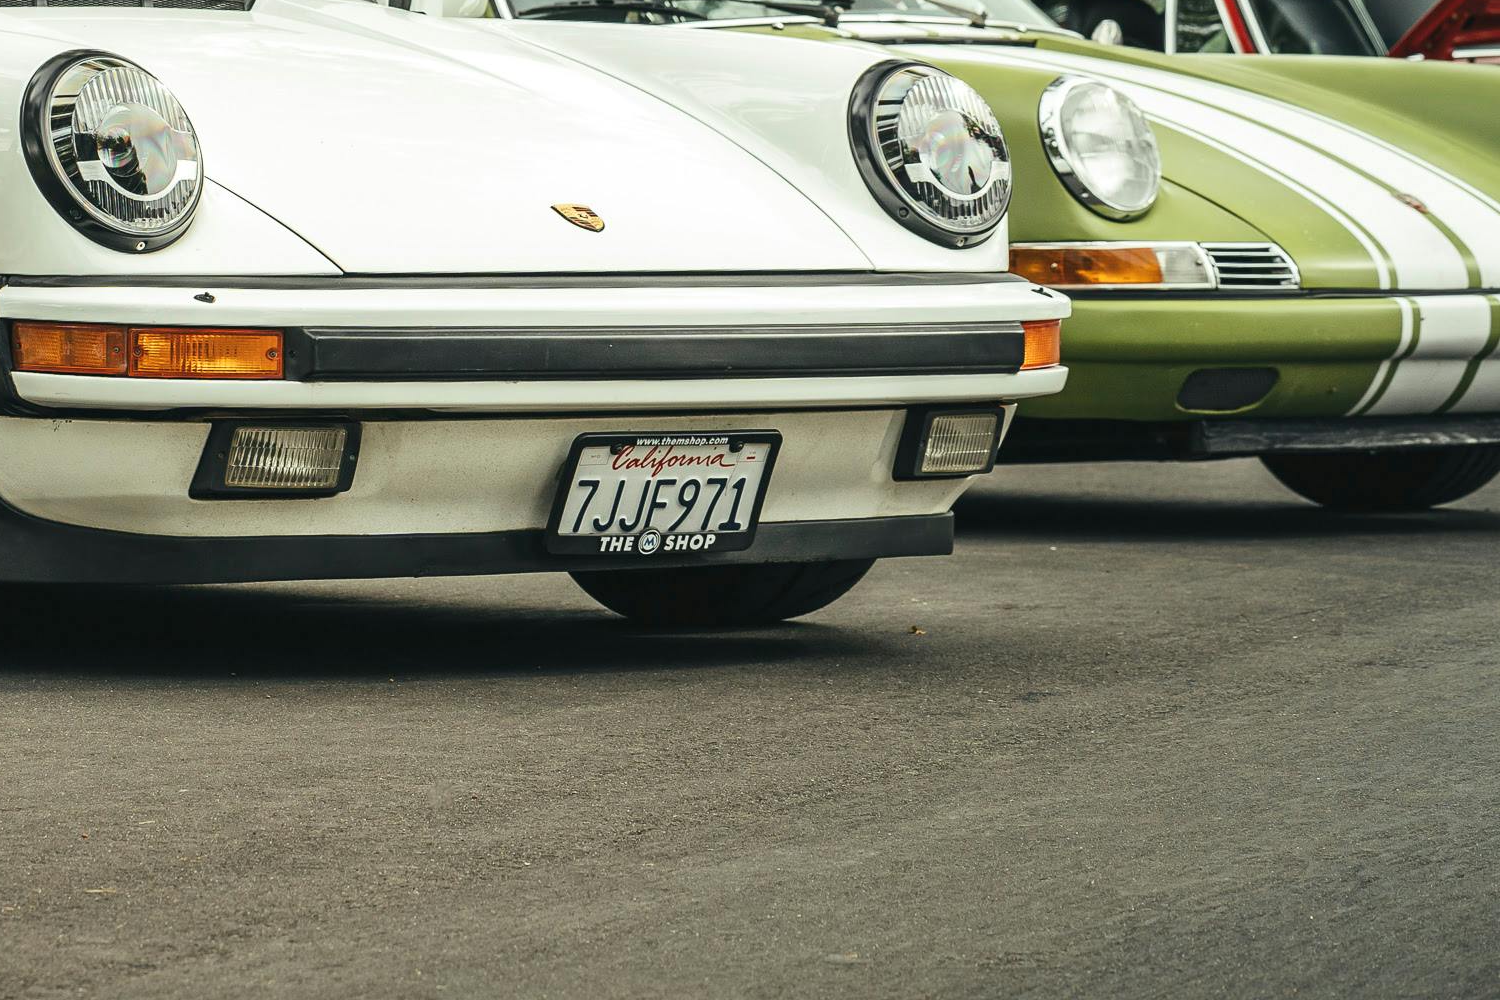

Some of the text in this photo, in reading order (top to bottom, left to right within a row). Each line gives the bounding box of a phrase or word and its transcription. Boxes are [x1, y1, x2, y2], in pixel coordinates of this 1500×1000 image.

[636, 436, 729, 446] www.themshop.com
[611, 444, 736, 478] California
[572, 477, 747, 533] 7JJF971
[600, 536, 635, 552] THE
[663, 534, 717, 551] SHOP
